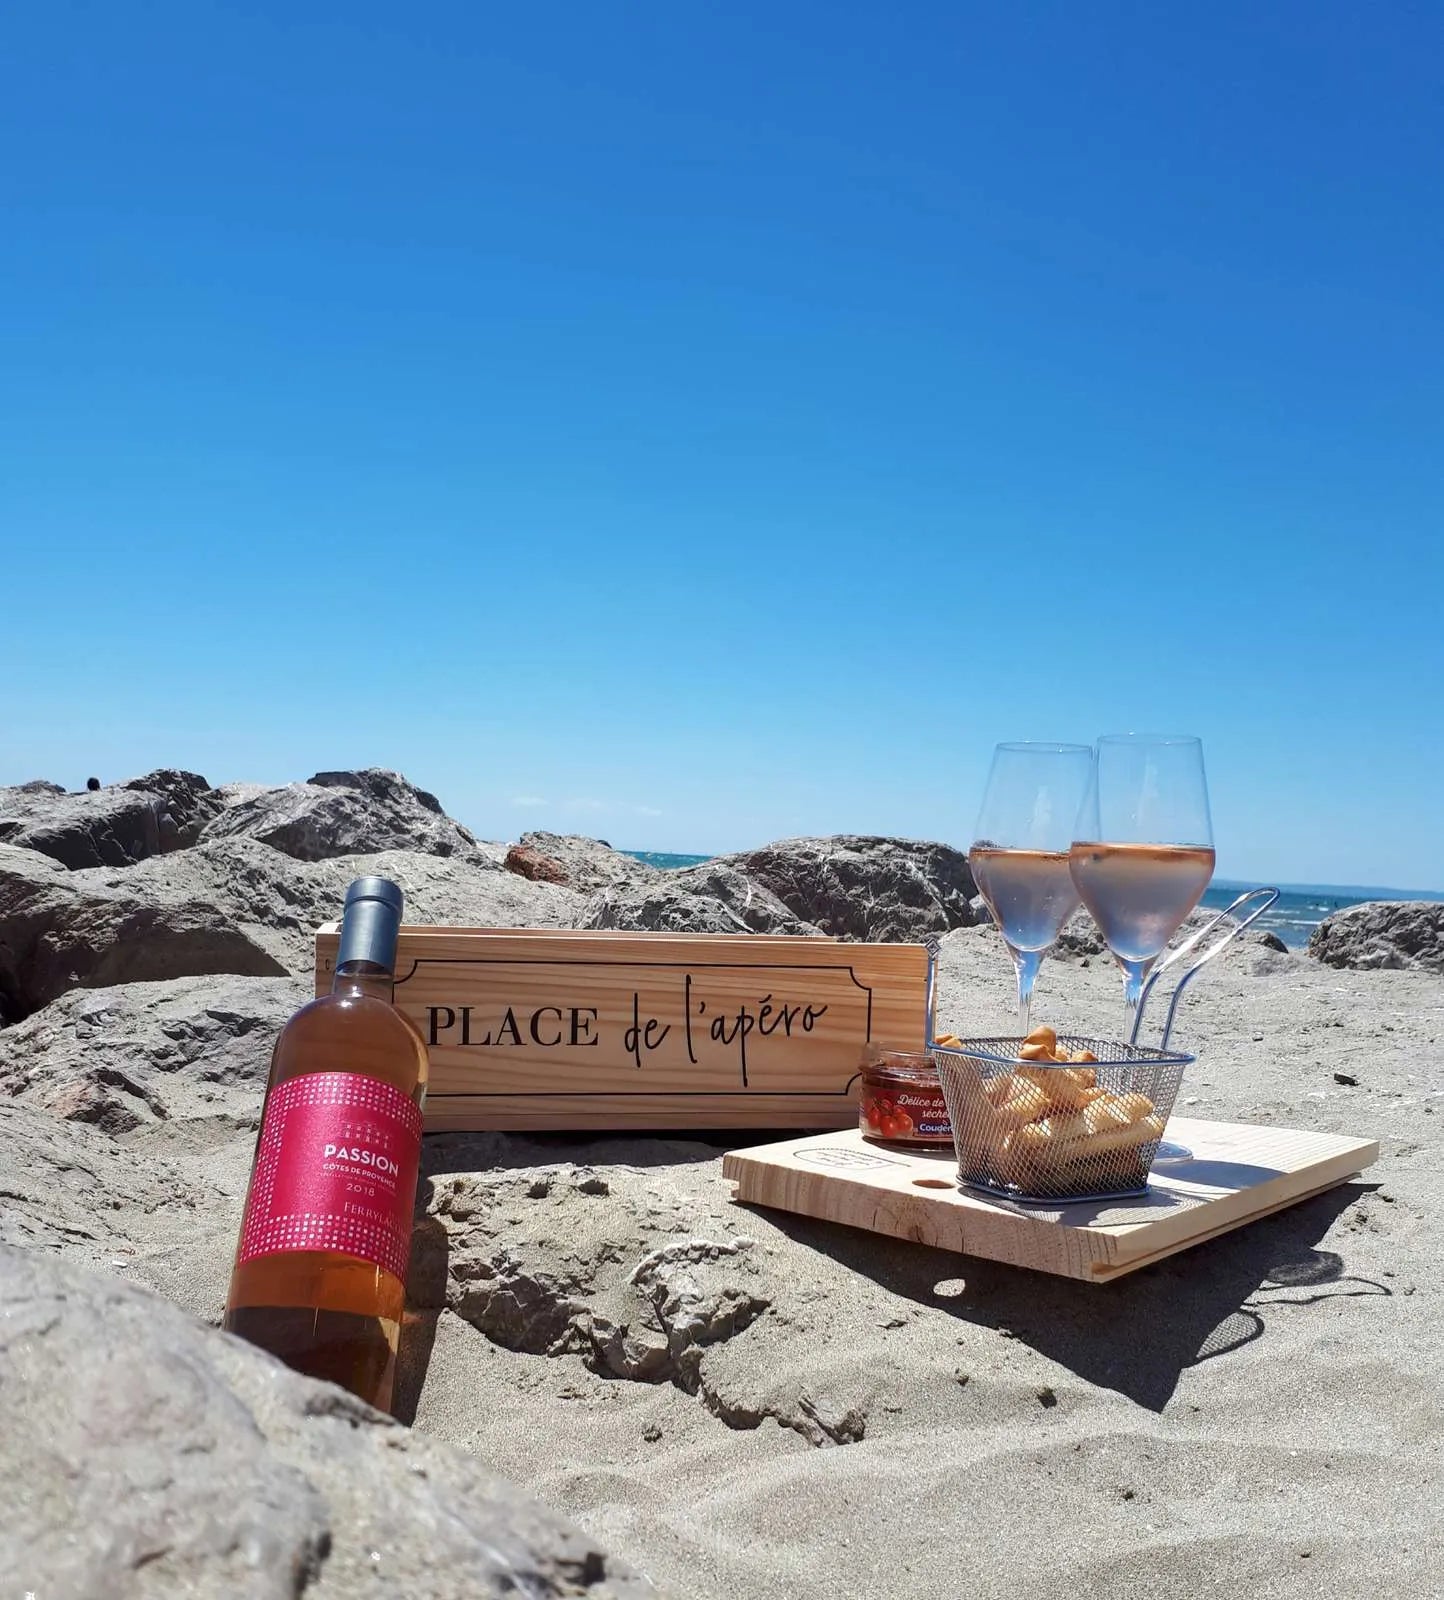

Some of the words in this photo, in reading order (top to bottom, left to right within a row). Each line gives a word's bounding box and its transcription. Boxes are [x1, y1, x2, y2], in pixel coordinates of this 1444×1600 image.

[426, 1006, 599, 1046] PLACE
[624, 992, 671, 1068] de
[686, 974, 828, 1087] l'apéro
[897, 1094, 930, 1106] Délice
[932, 1098, 944, 1108] de
[324, 1144, 399, 1176] PASSION
[351, 1167, 361, 1175] DE
[361, 1169, 396, 1189] PROVENCE
[346, 1183, 375, 1197] 2018
